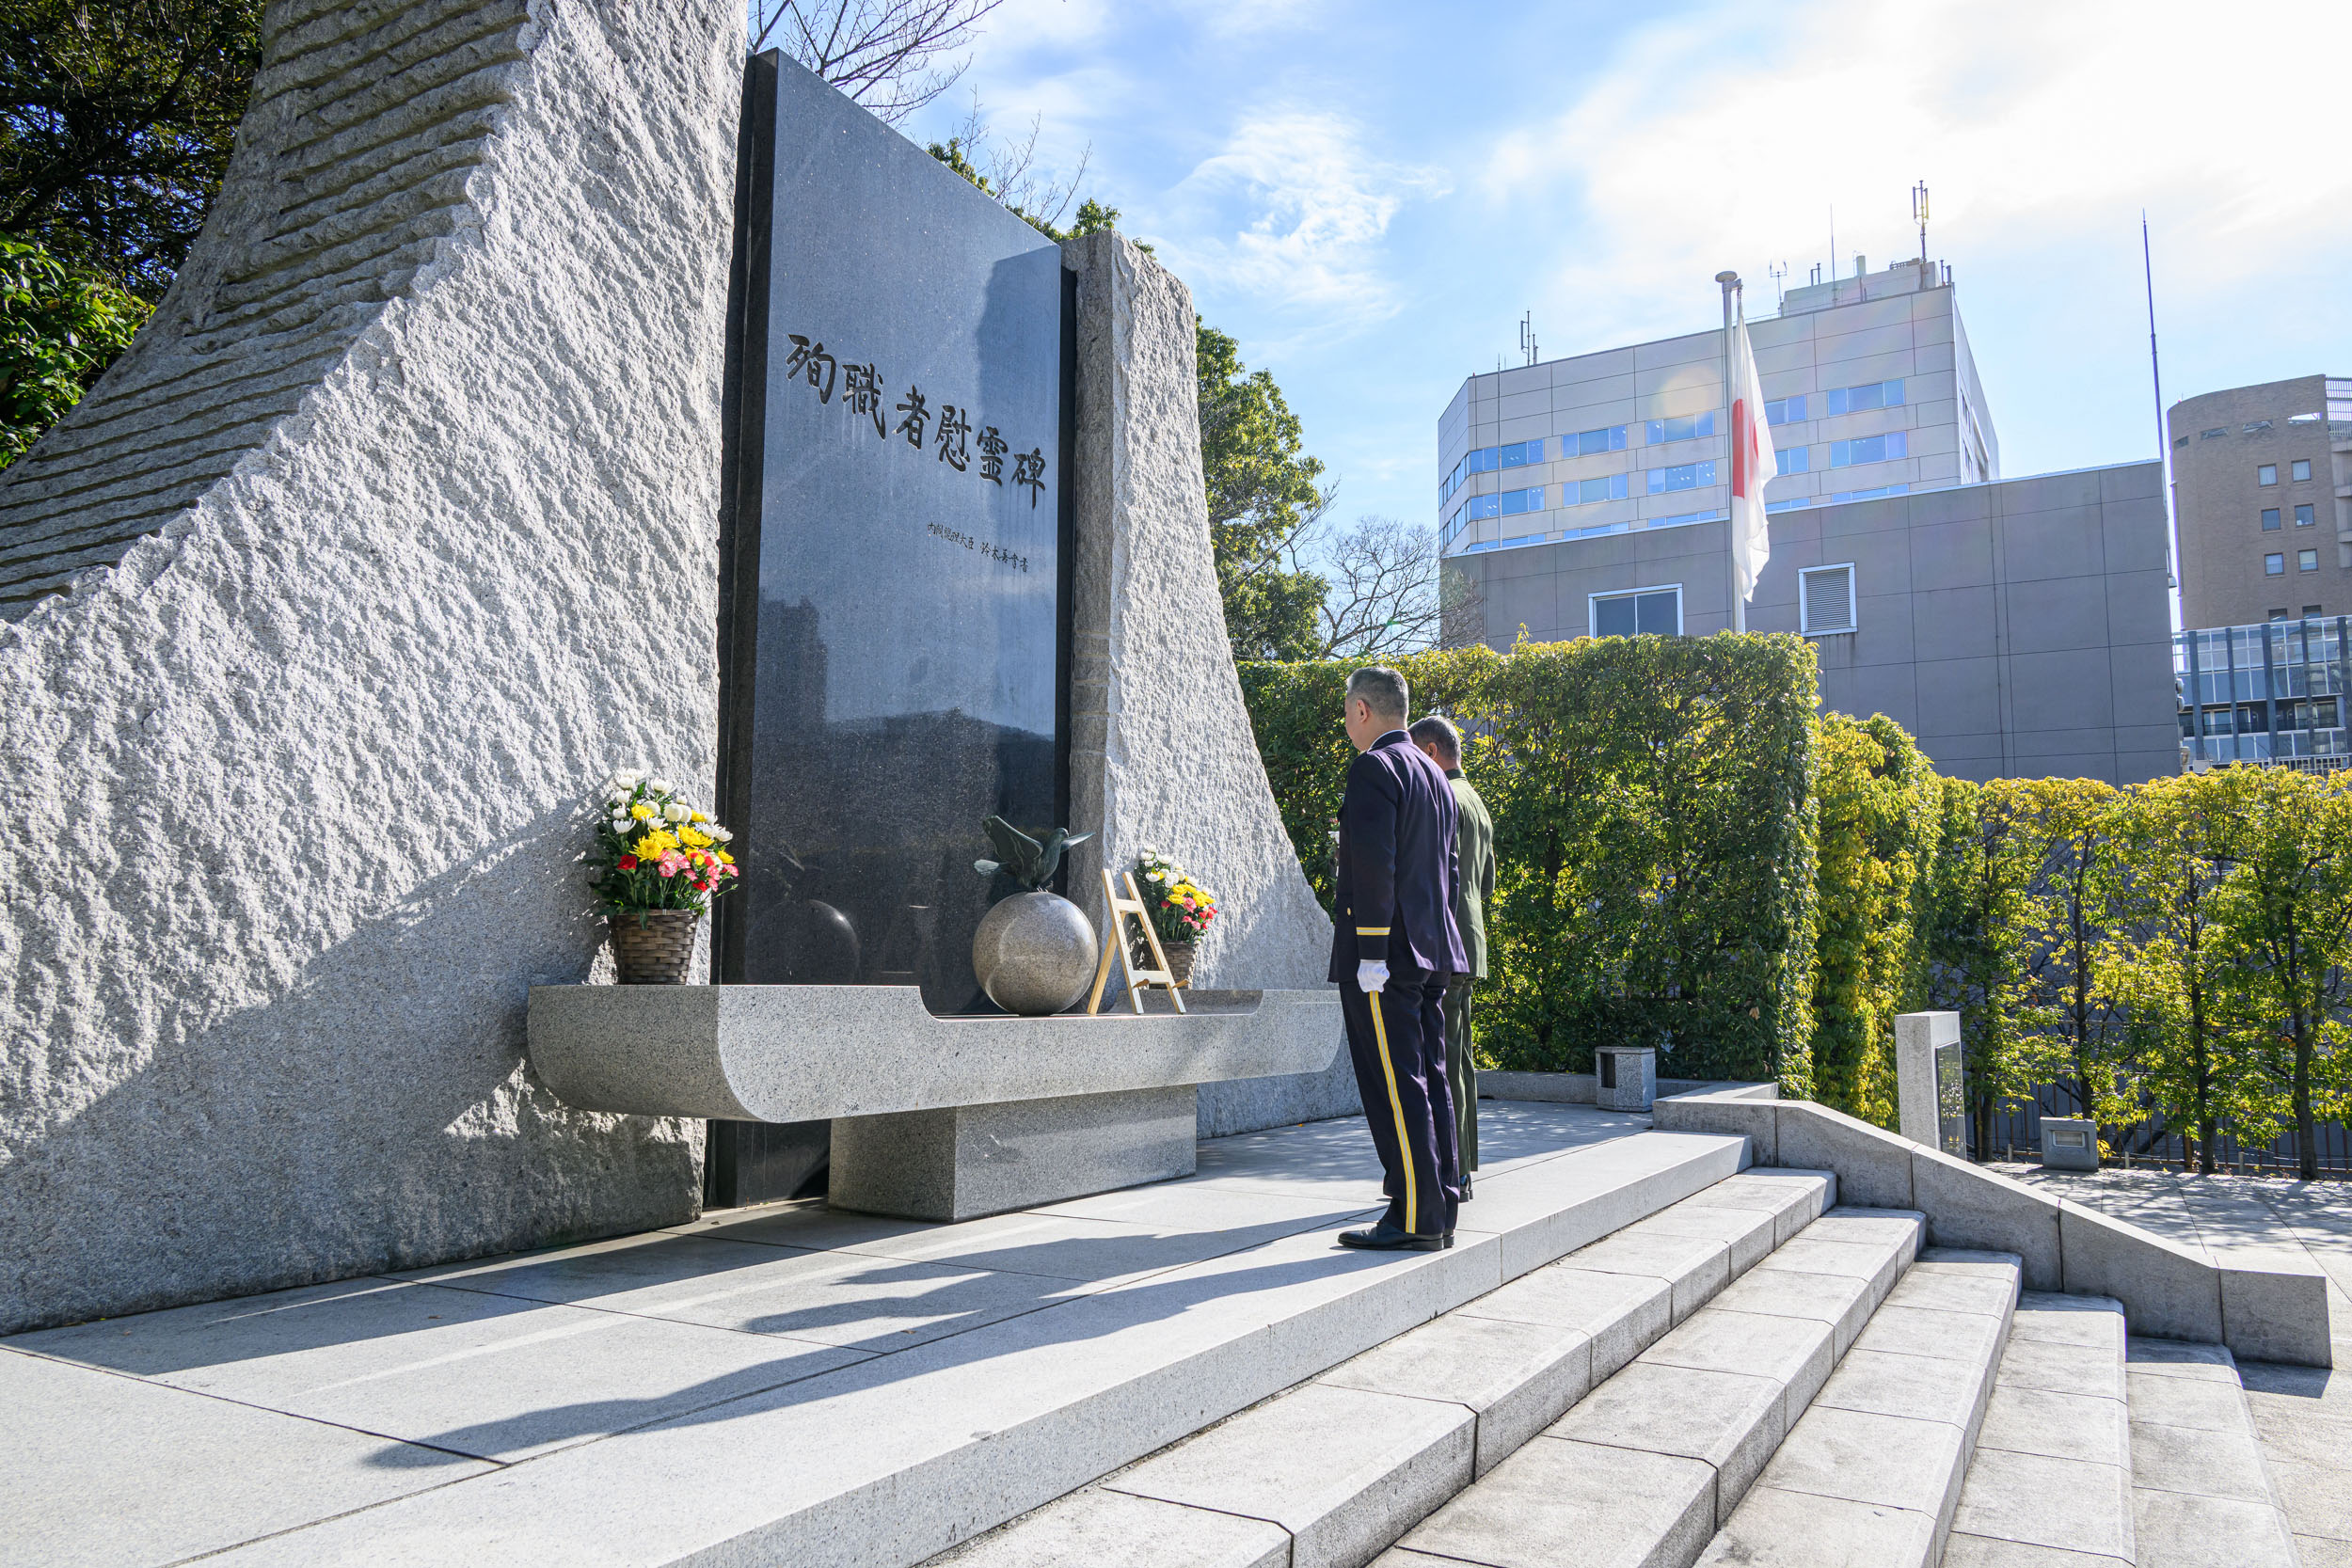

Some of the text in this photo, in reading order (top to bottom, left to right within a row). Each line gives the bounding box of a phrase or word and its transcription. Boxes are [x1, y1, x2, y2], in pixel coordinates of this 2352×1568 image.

[786, 333, 1046, 510] 殉職者慰霊碑
